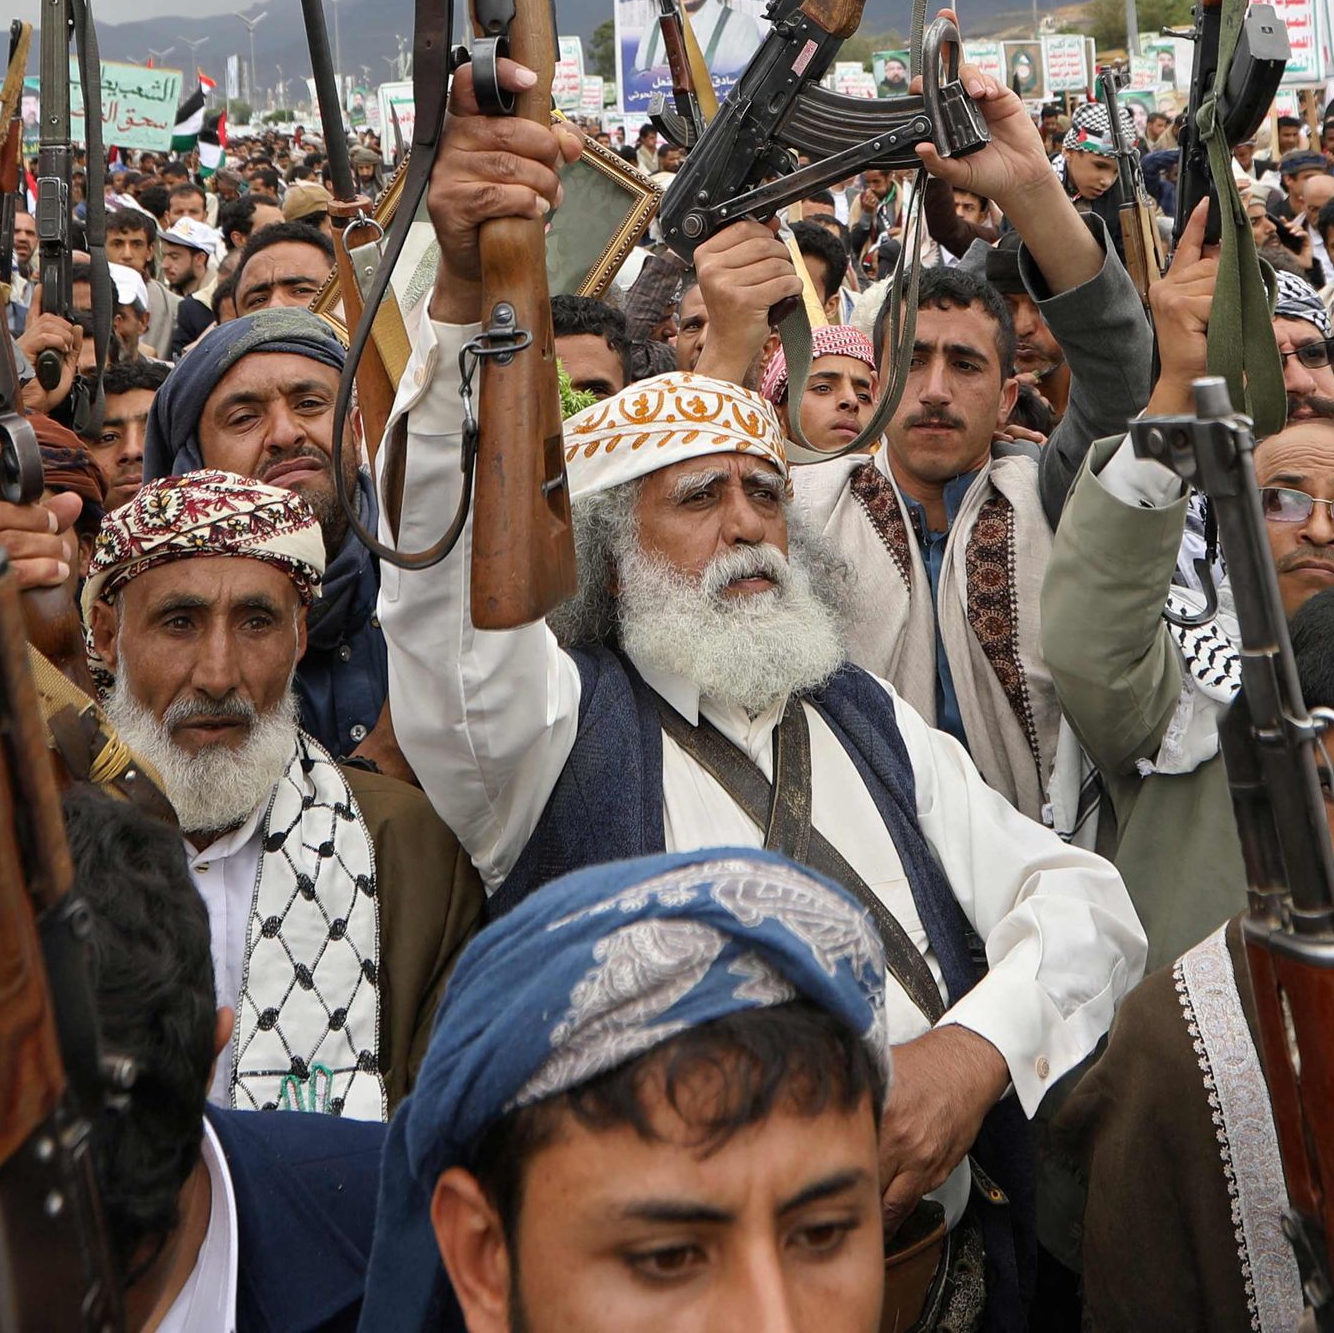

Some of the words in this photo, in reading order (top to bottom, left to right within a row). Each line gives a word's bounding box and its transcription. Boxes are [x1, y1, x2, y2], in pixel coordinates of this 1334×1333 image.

[1285, 13, 1313, 29] المو
[1285, 53, 1314, 73] النص
[118, 77, 176, 103] الشعب
[116, 107, 168, 133] سحق
